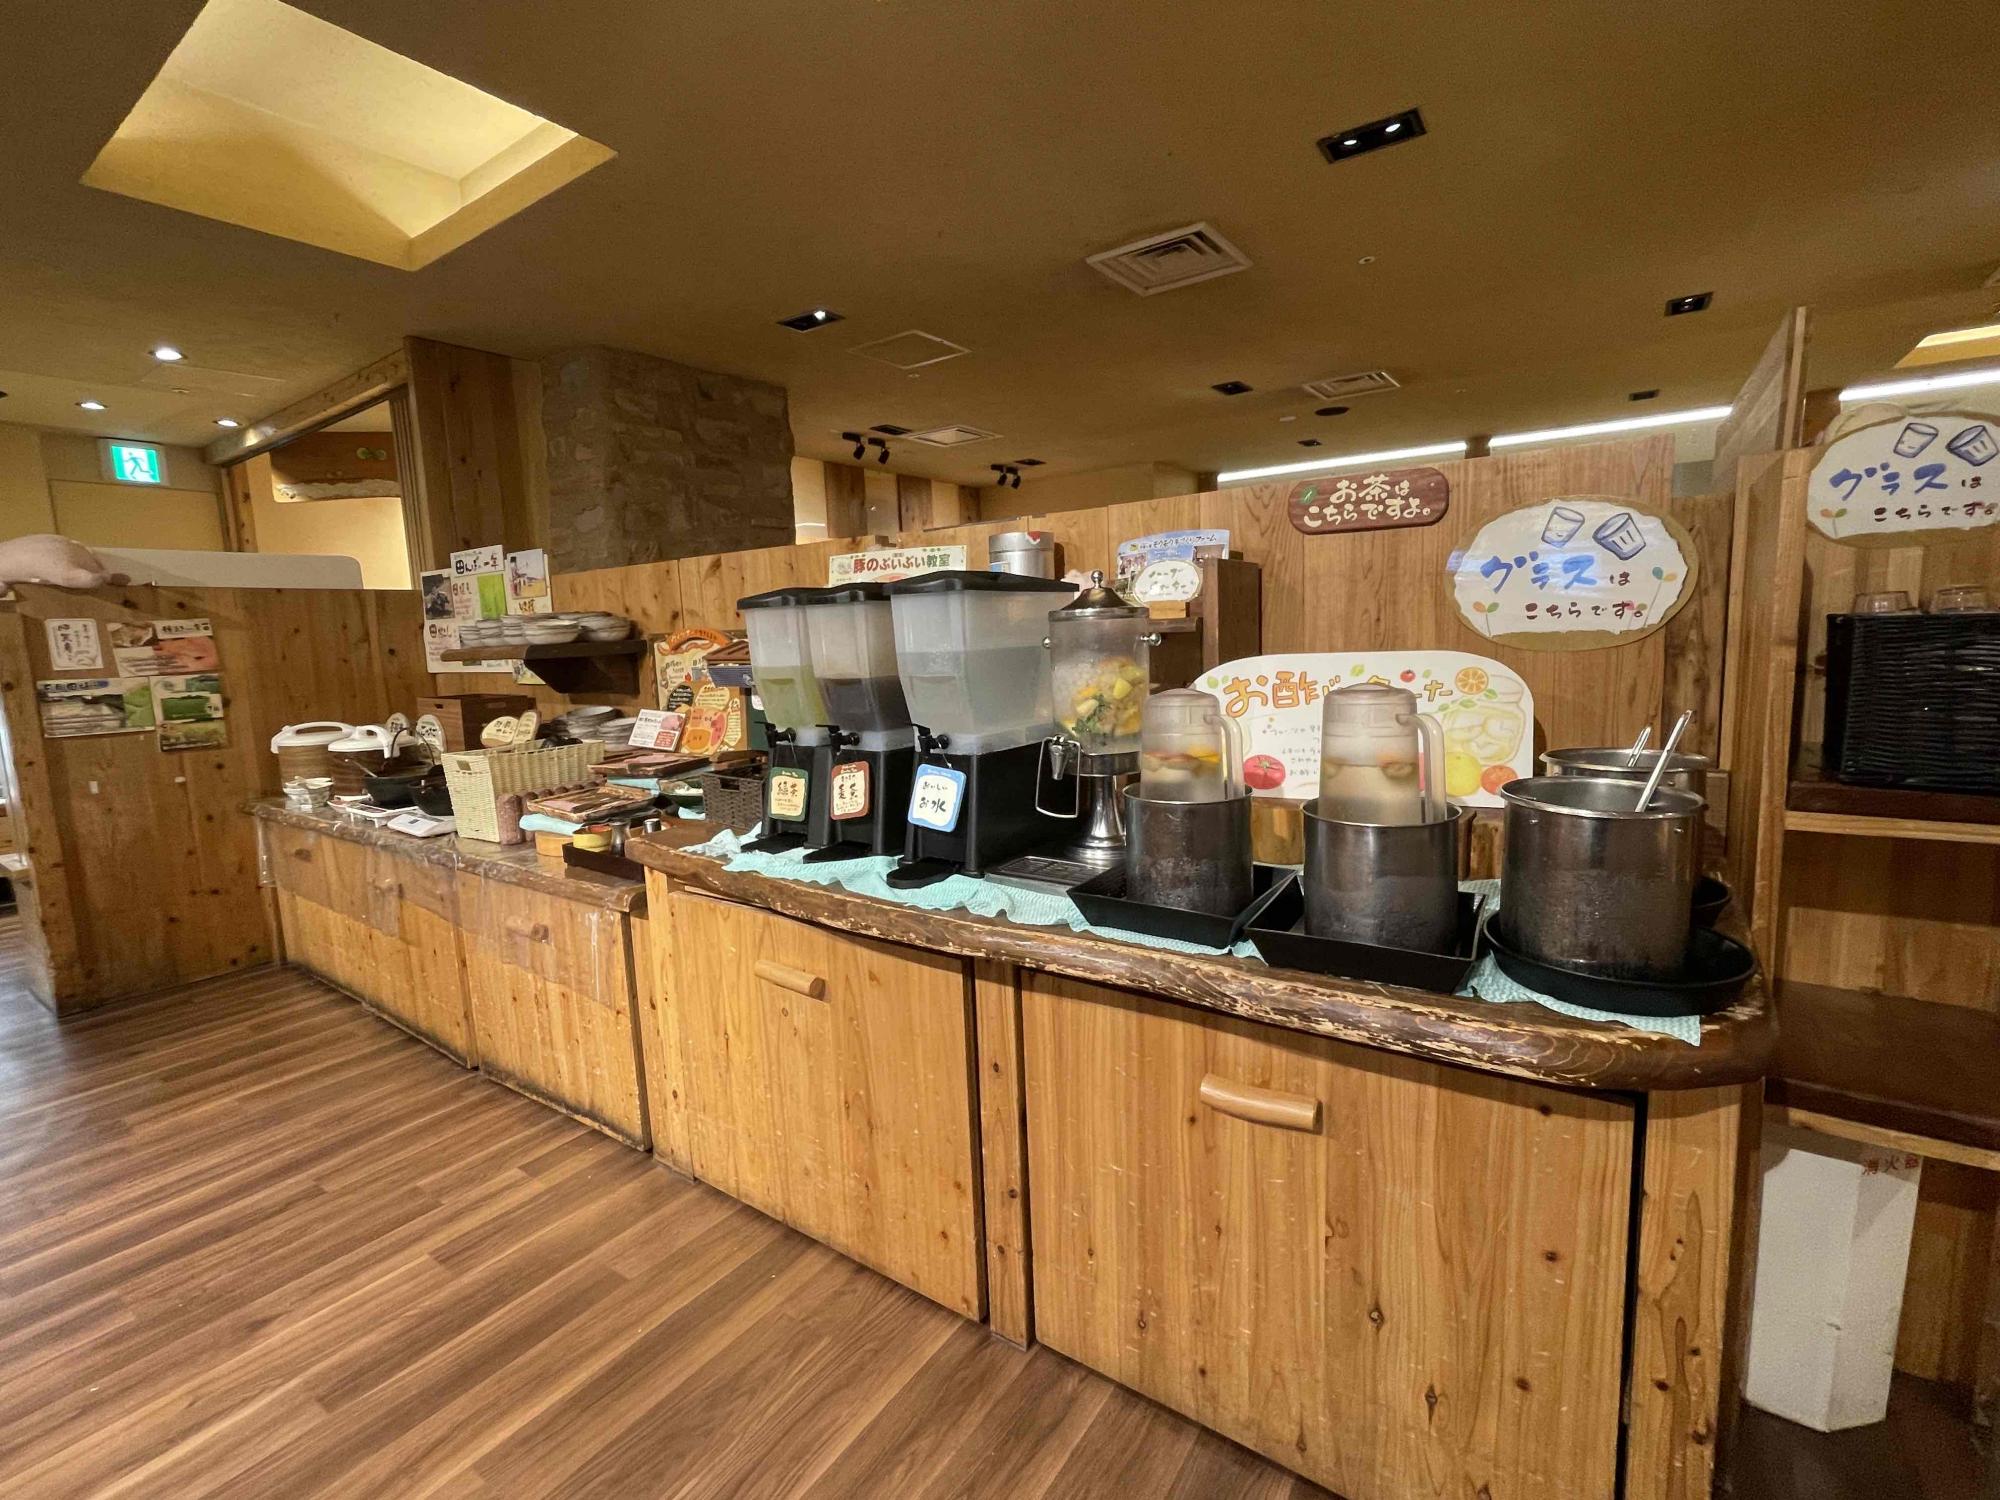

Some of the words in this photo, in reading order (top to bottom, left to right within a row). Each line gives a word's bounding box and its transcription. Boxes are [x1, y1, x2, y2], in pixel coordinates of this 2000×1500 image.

[1330, 474, 1410, 503] お茶は
[1829, 462, 1982, 501] グラスは
[1304, 497, 1431, 527] こちらですよ。
[1874, 502, 1995, 522] こちらです。
[1480, 551, 1631, 593] グラスは
[1525, 601, 1644, 620] こちらです。
[919, 797, 947, 813] お水
